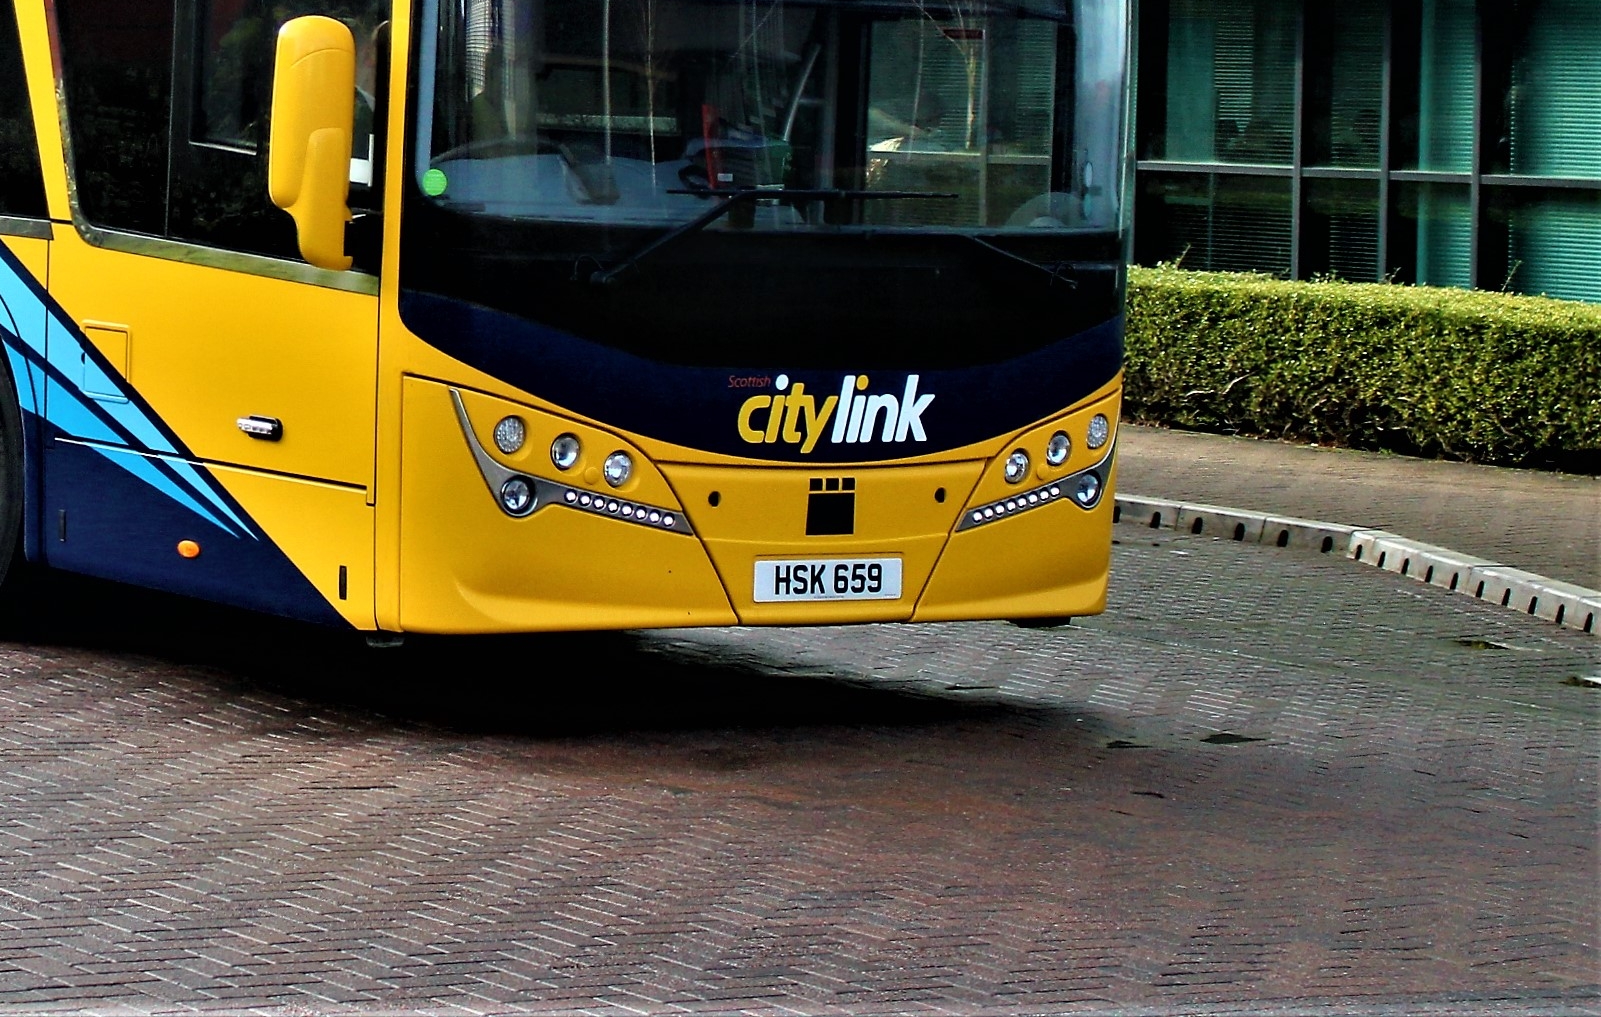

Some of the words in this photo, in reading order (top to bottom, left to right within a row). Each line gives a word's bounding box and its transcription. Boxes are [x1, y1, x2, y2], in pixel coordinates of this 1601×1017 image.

[727, 375, 771, 388] Scottish
[737, 373, 936, 454] citylink
[774, 564, 826, 595] HSK
[833, 563, 883, 594] 659
